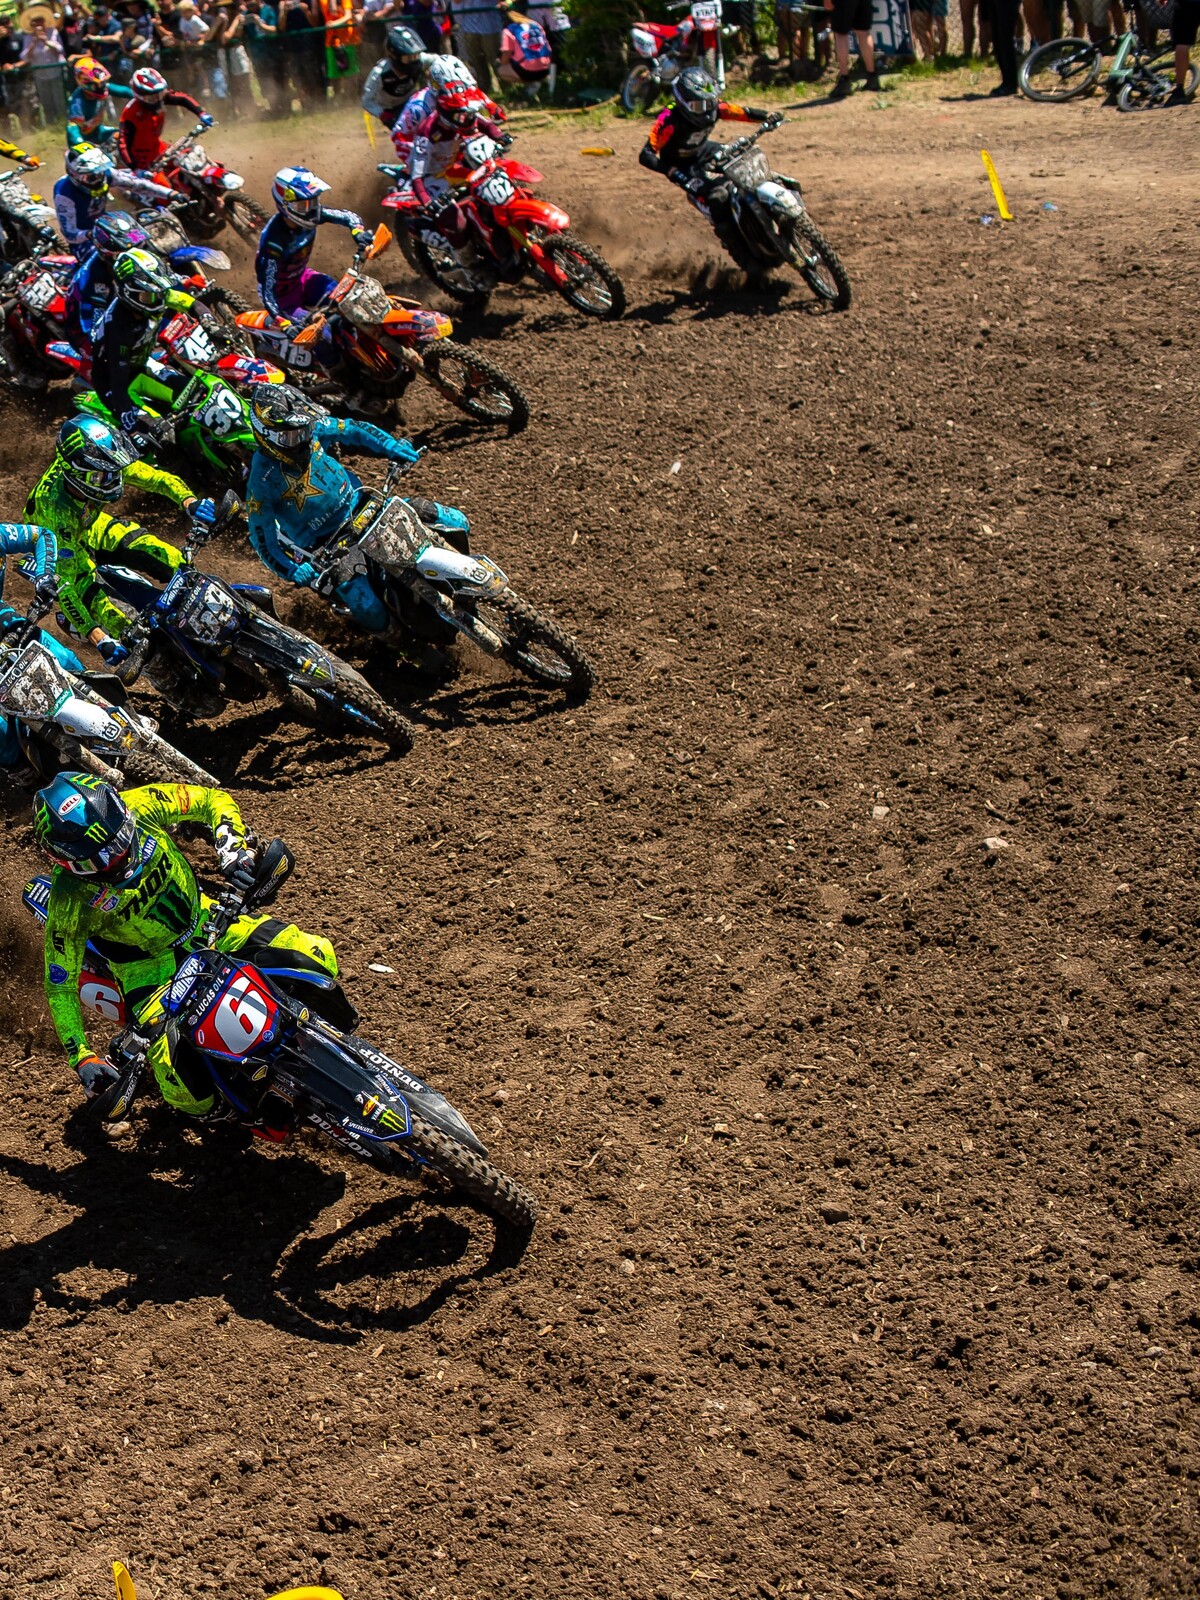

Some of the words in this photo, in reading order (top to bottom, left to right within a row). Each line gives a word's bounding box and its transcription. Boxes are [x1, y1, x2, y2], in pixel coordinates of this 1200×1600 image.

[480, 172, 515, 205] 162
[185, 324, 215, 363] 45
[278, 338, 312, 367] 115
[204, 388, 242, 436] 30
[62, 600, 86, 627] THOR
[61, 796, 79, 814] BELL
[118, 852, 172, 922] THOR
[170, 957, 199, 1003] PROTAPER
[196, 989, 216, 1017] LUCAS
[213, 978, 224, 992] OIL
[80, 982, 121, 1022] 6
[214, 976, 268, 1054] 6
[360, 1048, 425, 1092] DUNLOP
